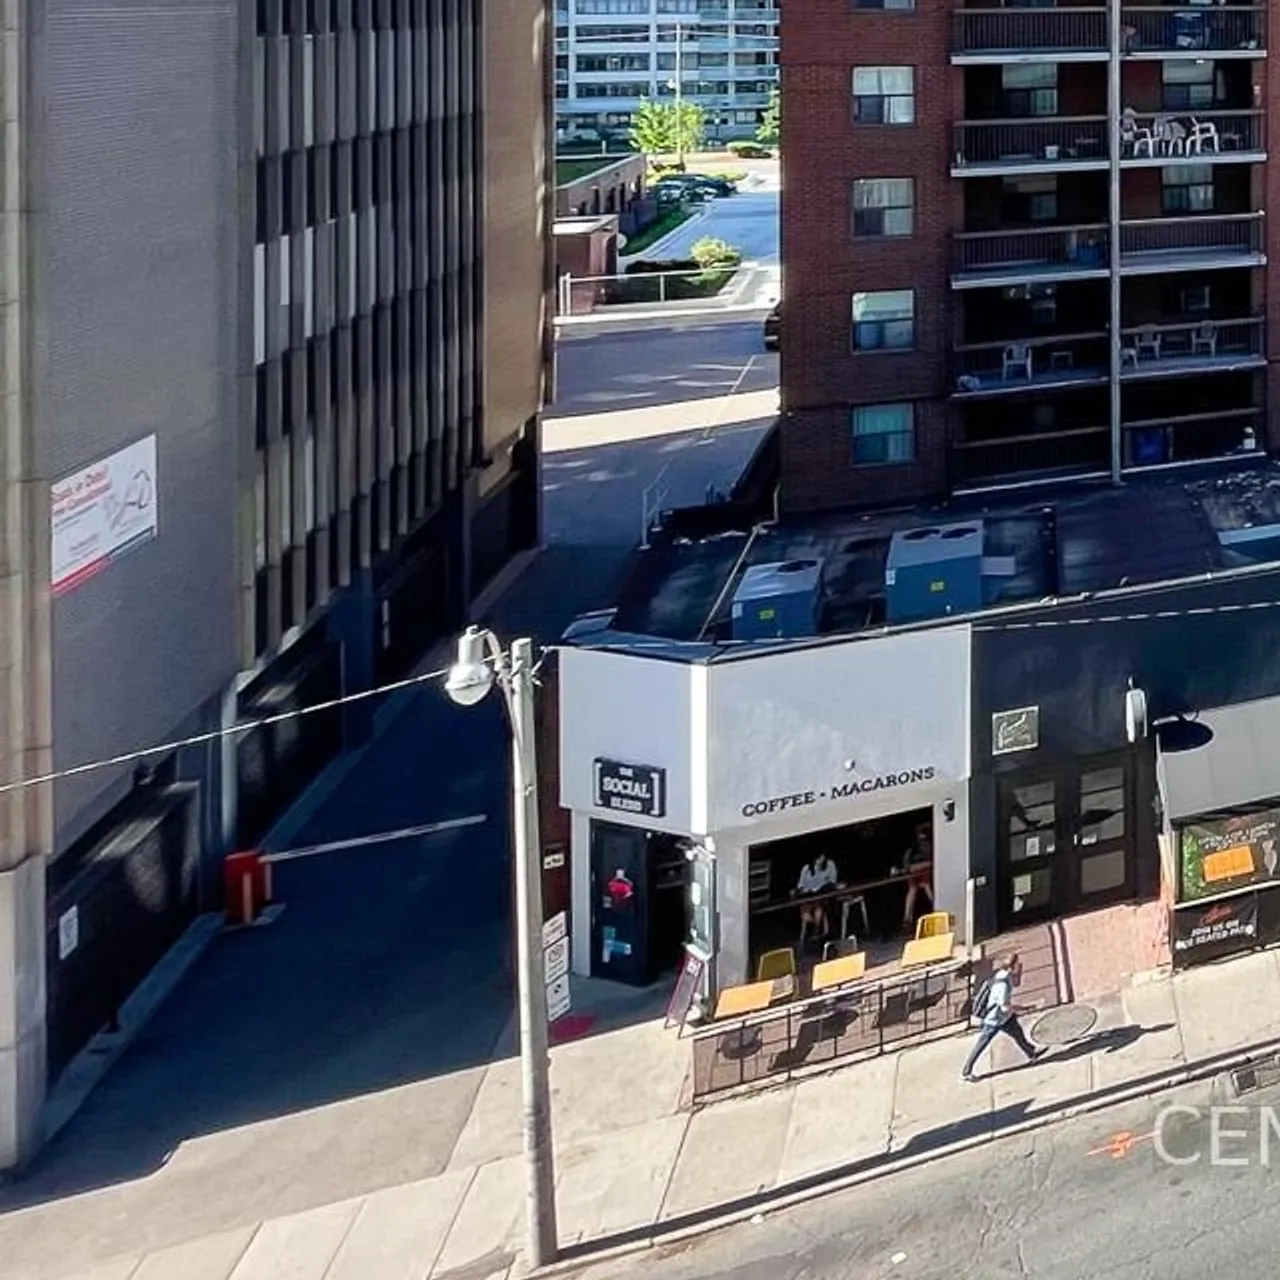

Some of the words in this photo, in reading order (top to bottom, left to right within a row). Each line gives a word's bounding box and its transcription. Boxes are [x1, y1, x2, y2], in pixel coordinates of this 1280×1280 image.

[602, 776, 652, 799] SOCIAL
[742, 791, 815, 817] COFFEE
[830, 766, 935, 800] MACARONS
